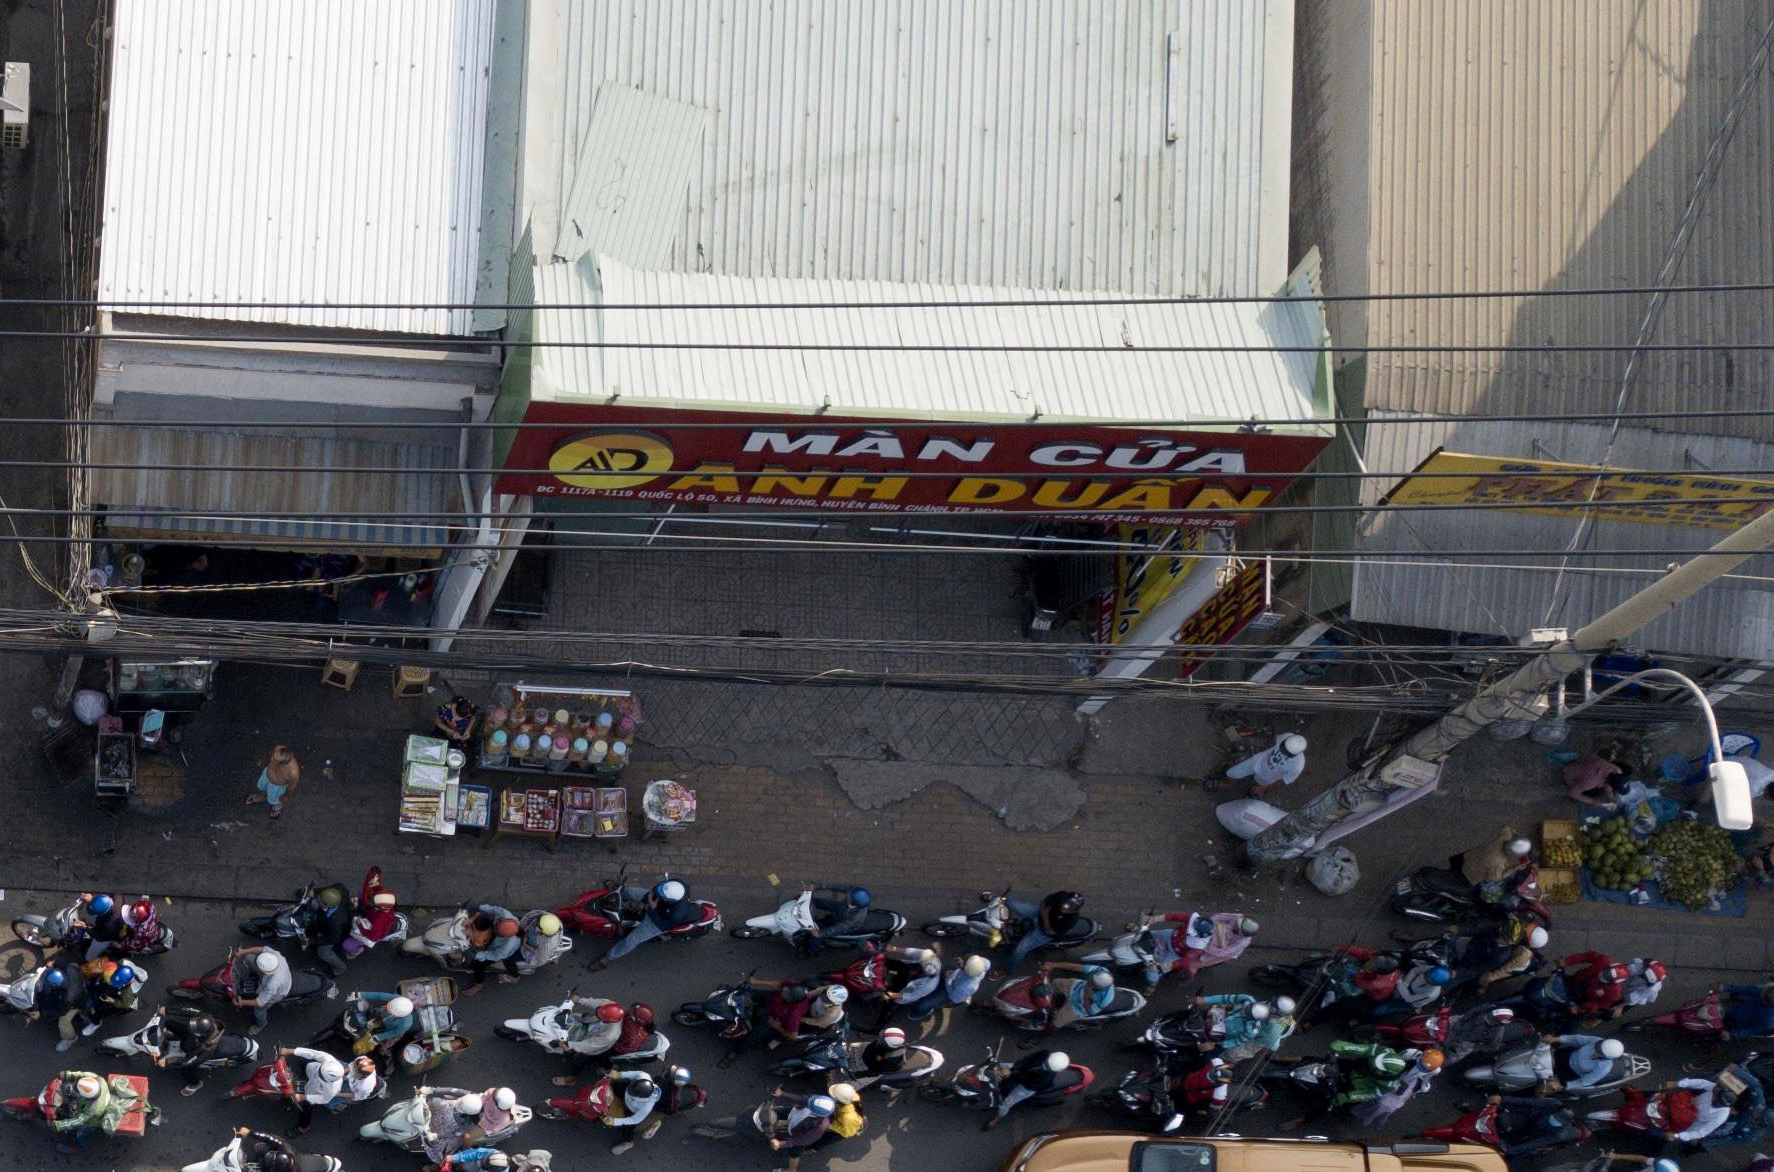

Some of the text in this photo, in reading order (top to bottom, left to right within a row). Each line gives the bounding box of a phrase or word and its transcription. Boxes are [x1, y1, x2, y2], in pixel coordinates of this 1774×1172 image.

[742, 429, 1245, 473] MÀN CỬA
[638, 490, 673, 500] QUỐC
[676, 491, 694, 502] LỘ
[746, 495, 779, 506] BÌNH
[667, 463, 909, 500] ANH
